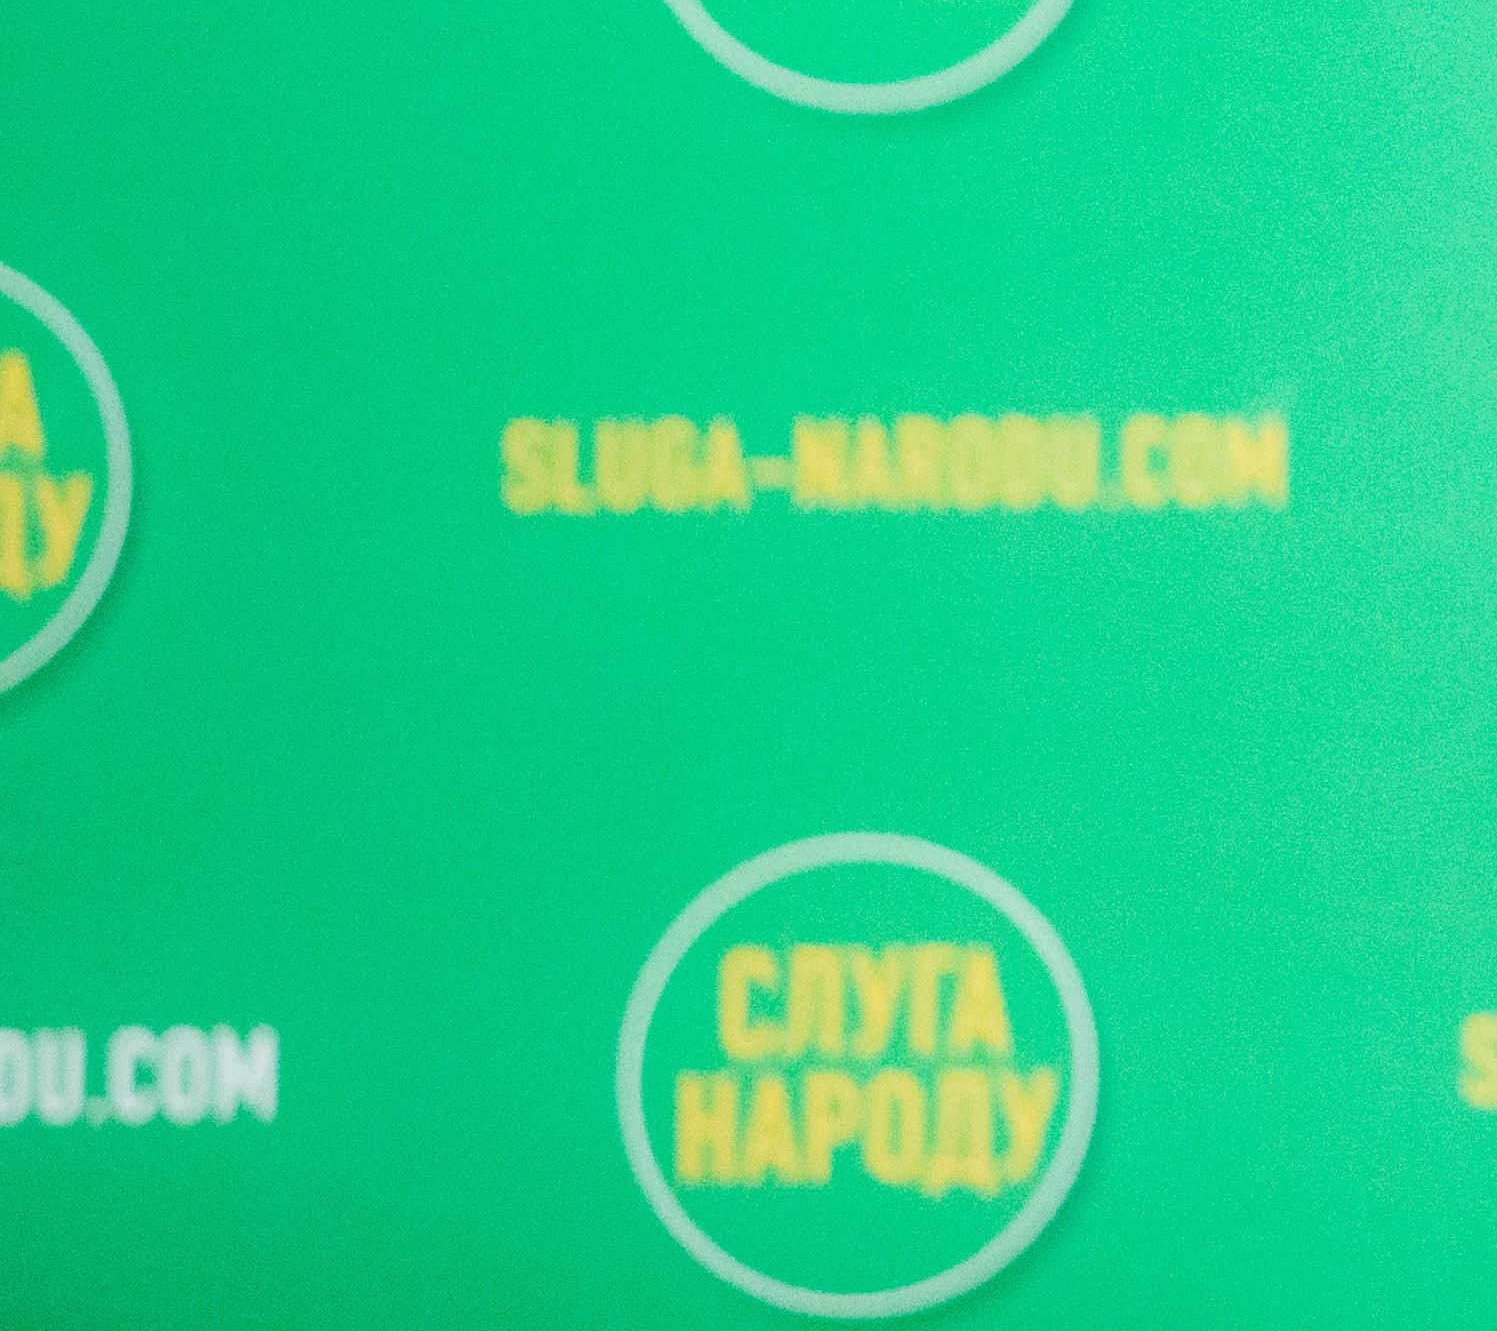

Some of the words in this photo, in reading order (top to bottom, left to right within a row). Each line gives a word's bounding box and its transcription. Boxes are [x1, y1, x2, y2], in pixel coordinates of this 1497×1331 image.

[502, 411, 1291, 513] SLUGA-NARODU.COM
[719, 943, 1012, 1059] СЛУГА
[678, 1061, 1058, 1193] НАРОДУ
